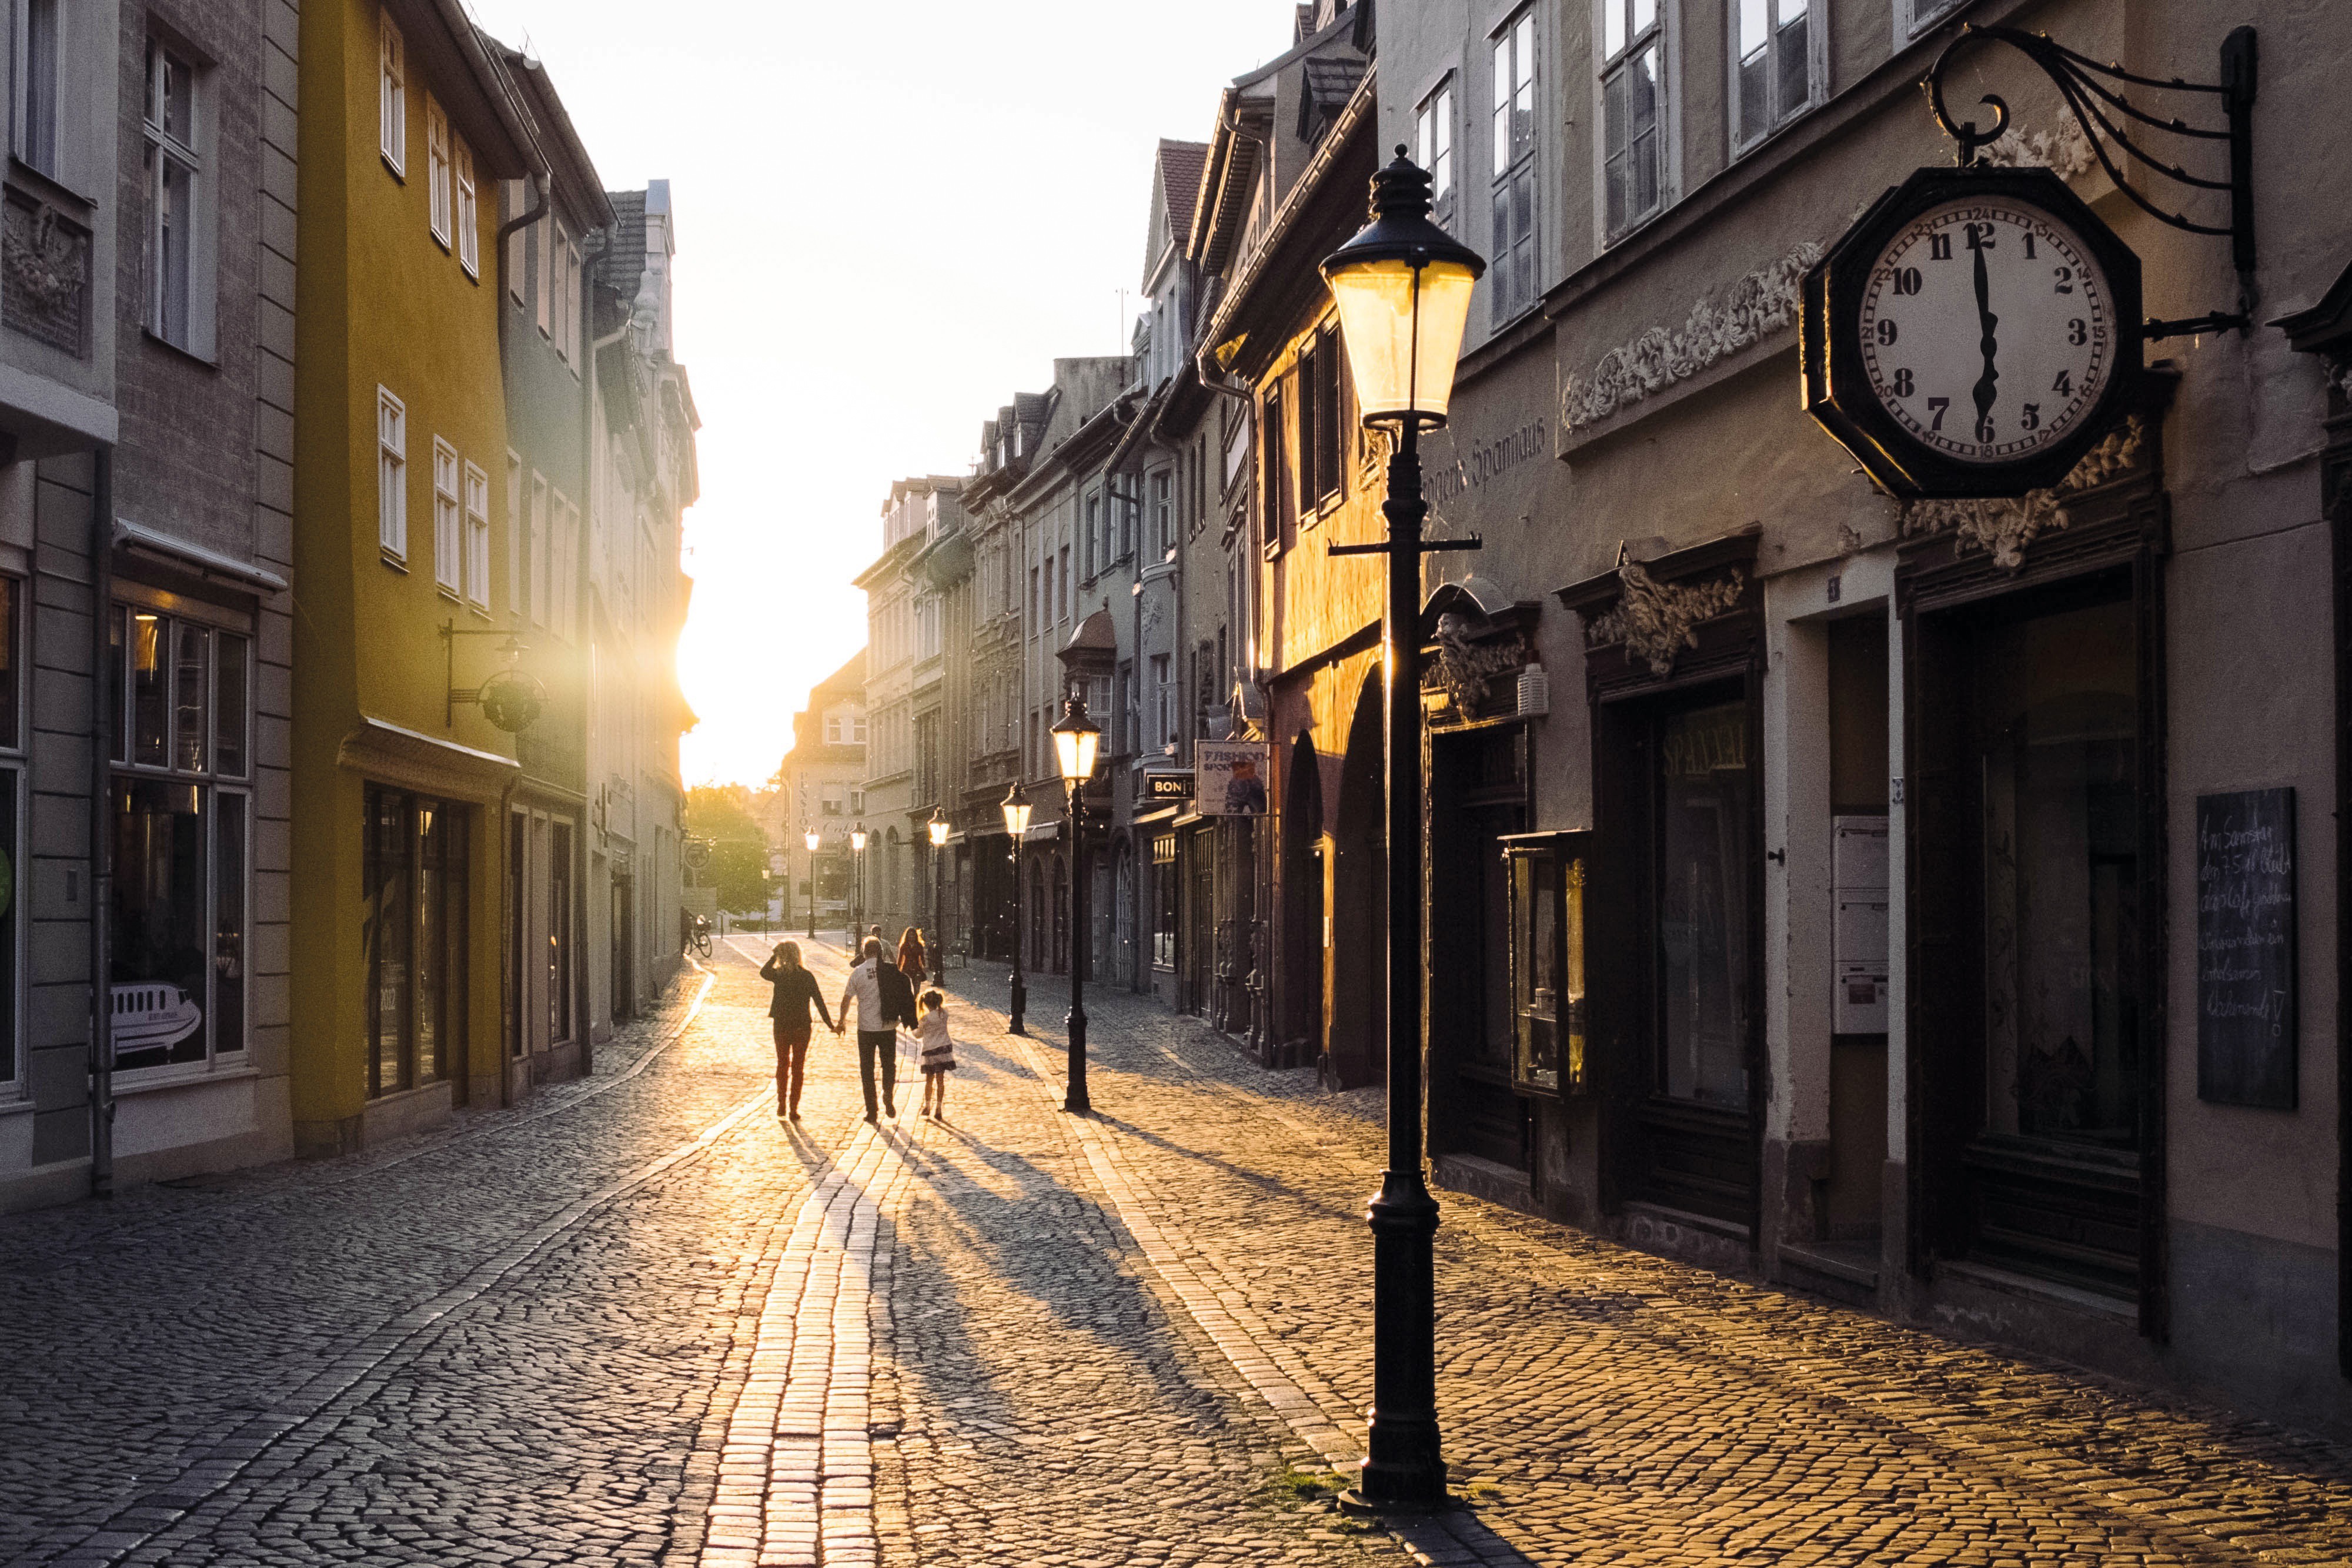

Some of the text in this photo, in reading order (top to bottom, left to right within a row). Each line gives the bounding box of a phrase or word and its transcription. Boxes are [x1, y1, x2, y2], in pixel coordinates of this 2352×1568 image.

[1973, 208, 1990, 220] 24
[1915, 223, 1933, 236] 23
[1963, 222, 1996, 249] 12
[2034, 225, 2047, 237] 13
[1928, 233, 1953, 260] 11
[2022, 232, 2037, 260] 1
[1874, 268, 1891, 280] 22
[1891, 268, 1922, 295] 10
[2054, 267, 2073, 294] 2
[2077, 268, 2091, 280] 14
[1861, 326, 1874, 339] 21
[1877, 319, 1897, 346] 9
[2068, 319, 2087, 346] 3
[2092, 326, 2105, 339] 15
[1876, 385, 1893, 397] 20
[1894, 368, 1915, 397] 8
[2052, 369, 2074, 397] 4
[2079, 385, 2092, 397] 16
[1928, 397, 1949, 430] 7
[2021, 402, 2040, 430] 5
[1922, 431, 1936, 443] 19
[1975, 416, 1995, 444] 6
[2038, 430, 2051, 442] 17
[1472, 417, 1545, 494] Spannaus
[1980, 444, 1993, 457] 18
[1204, 751, 1265, 761] FASHION
